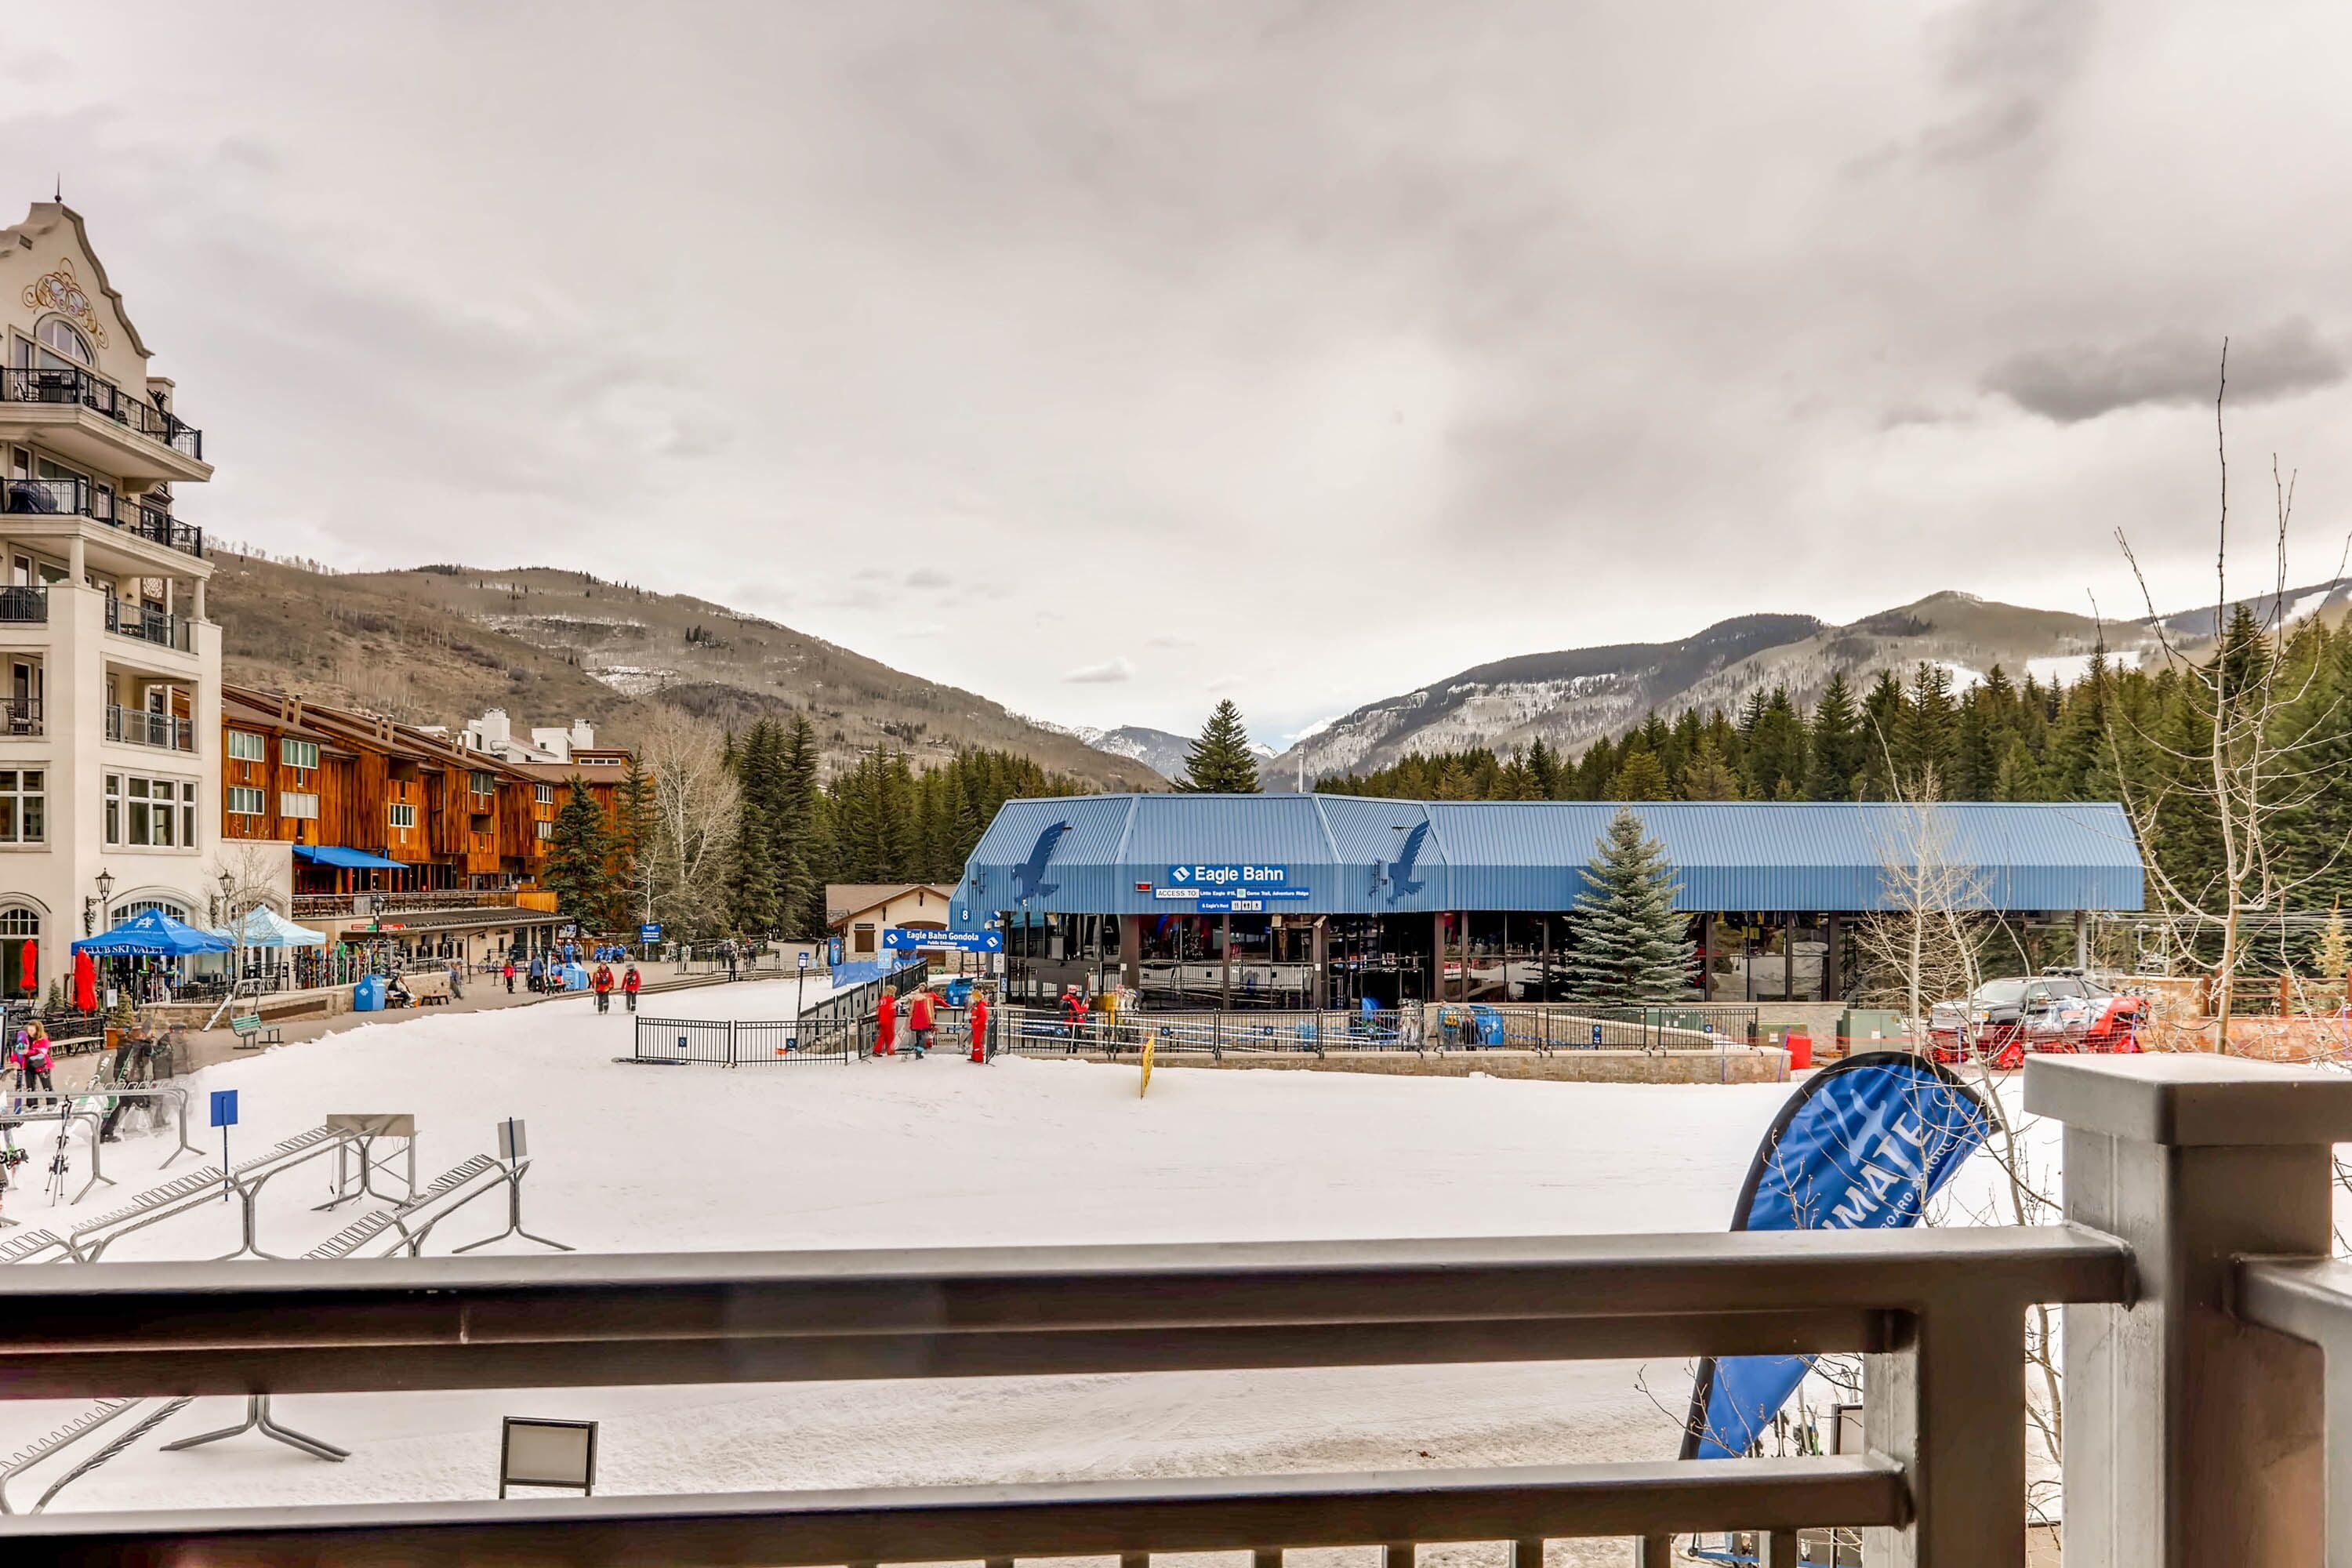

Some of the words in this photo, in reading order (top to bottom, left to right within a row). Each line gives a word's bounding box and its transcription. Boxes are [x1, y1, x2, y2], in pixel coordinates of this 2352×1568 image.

[1195, 866, 1239, 884] Eagle
[1243, 866, 1283, 880] Bahn
[962, 909, 969, 920] 8
[906, 931, 927, 941] Eagle
[927, 931, 947, 940] Bahn
[949, 932, 979, 941] Gondola
